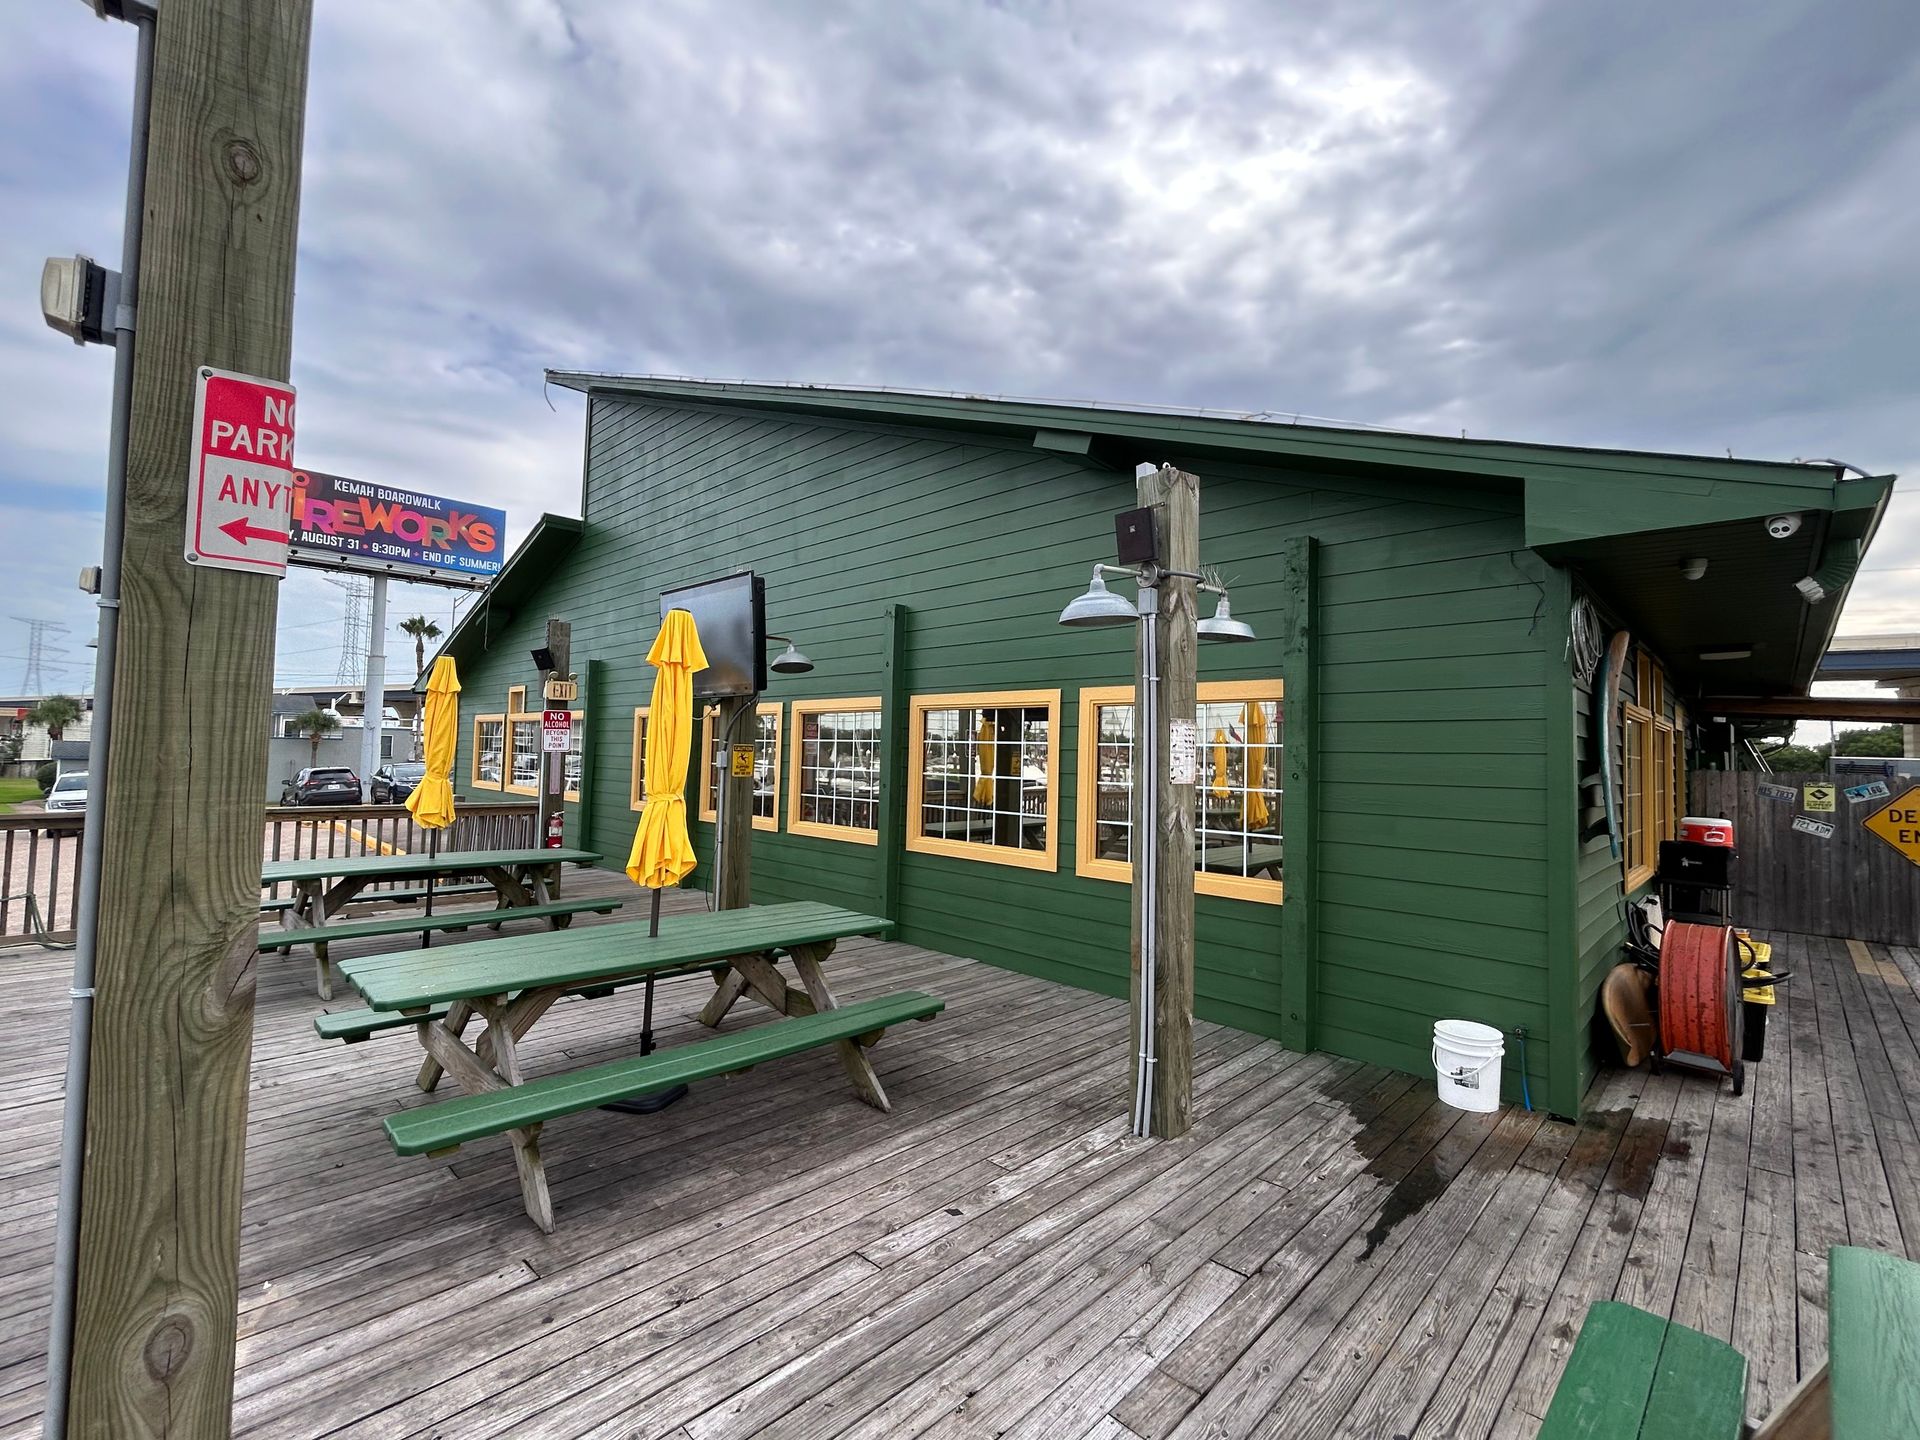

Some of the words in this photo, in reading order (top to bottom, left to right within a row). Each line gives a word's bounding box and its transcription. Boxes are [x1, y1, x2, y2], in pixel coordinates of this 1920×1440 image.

[211, 420, 294, 463] PARK
[334, 479, 374, 498] KEMAH
[378, 488, 442, 511] BOARDWALK
[302, 532, 343, 548] AUGUST
[347, 538, 359, 550] 31
[372, 542, 411, 558] 9:30PM
[423, 551, 442, 564] END
[444, 554, 456, 565] OF
[553, 683, 573, 698] EXIT
[1889, 809, 1917, 823] DE
